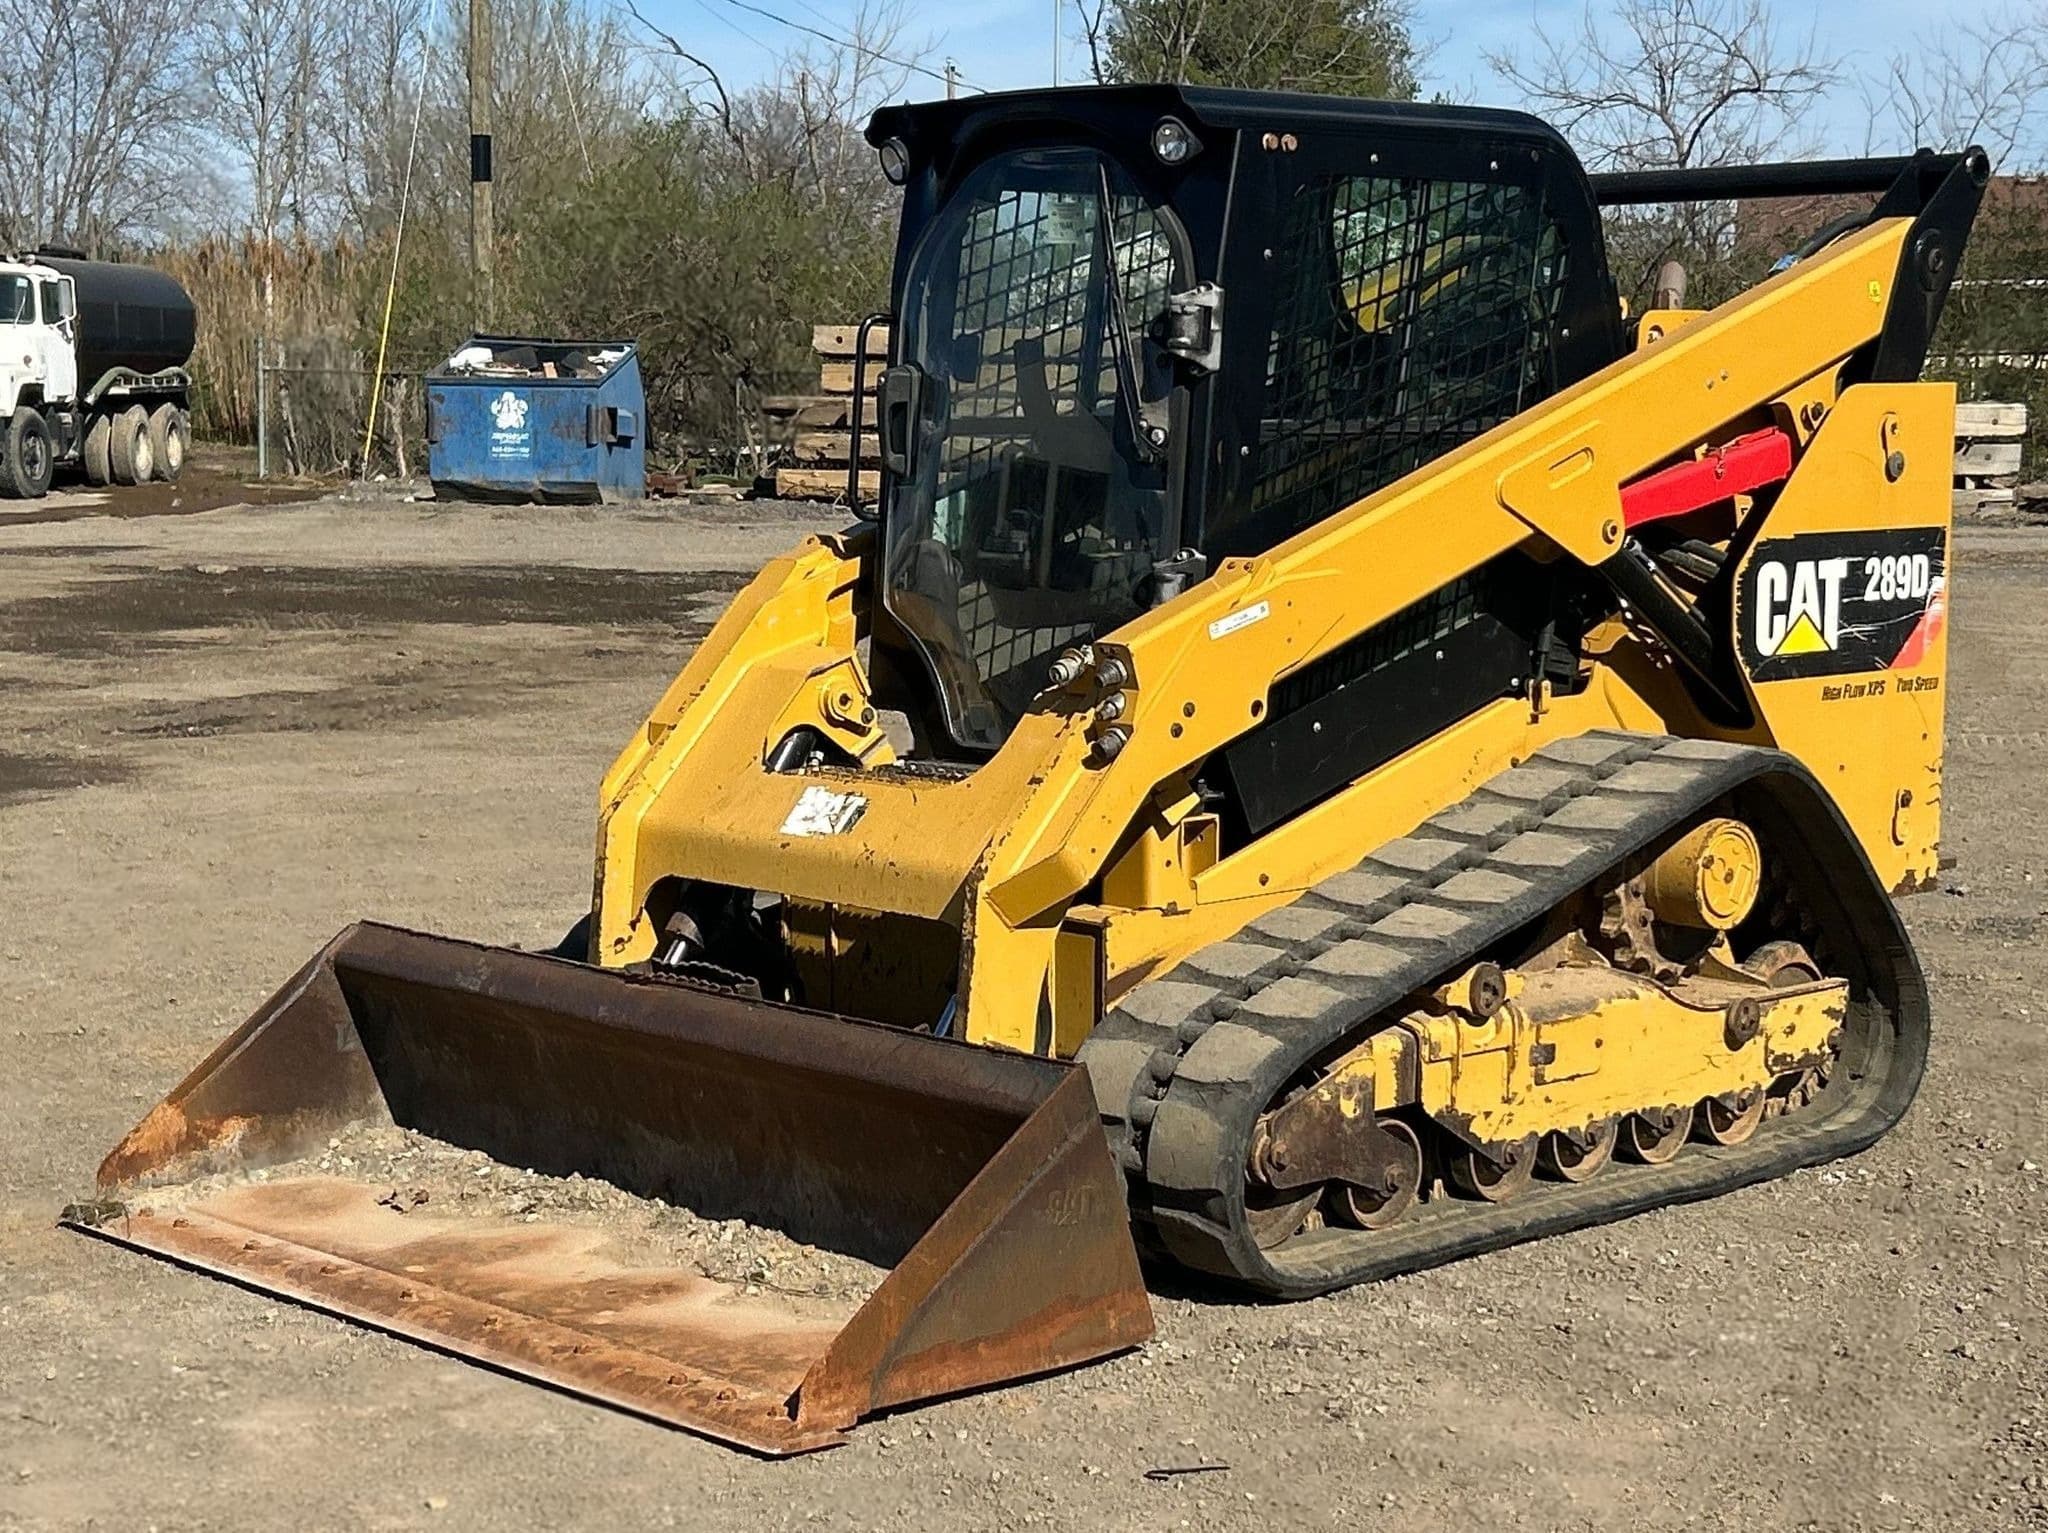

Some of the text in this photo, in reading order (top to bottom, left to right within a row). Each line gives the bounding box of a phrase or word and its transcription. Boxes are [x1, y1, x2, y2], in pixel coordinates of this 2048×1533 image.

[1755, 553, 1930, 657] CAT 289D
[1866, 680, 1886, 696] XPS
